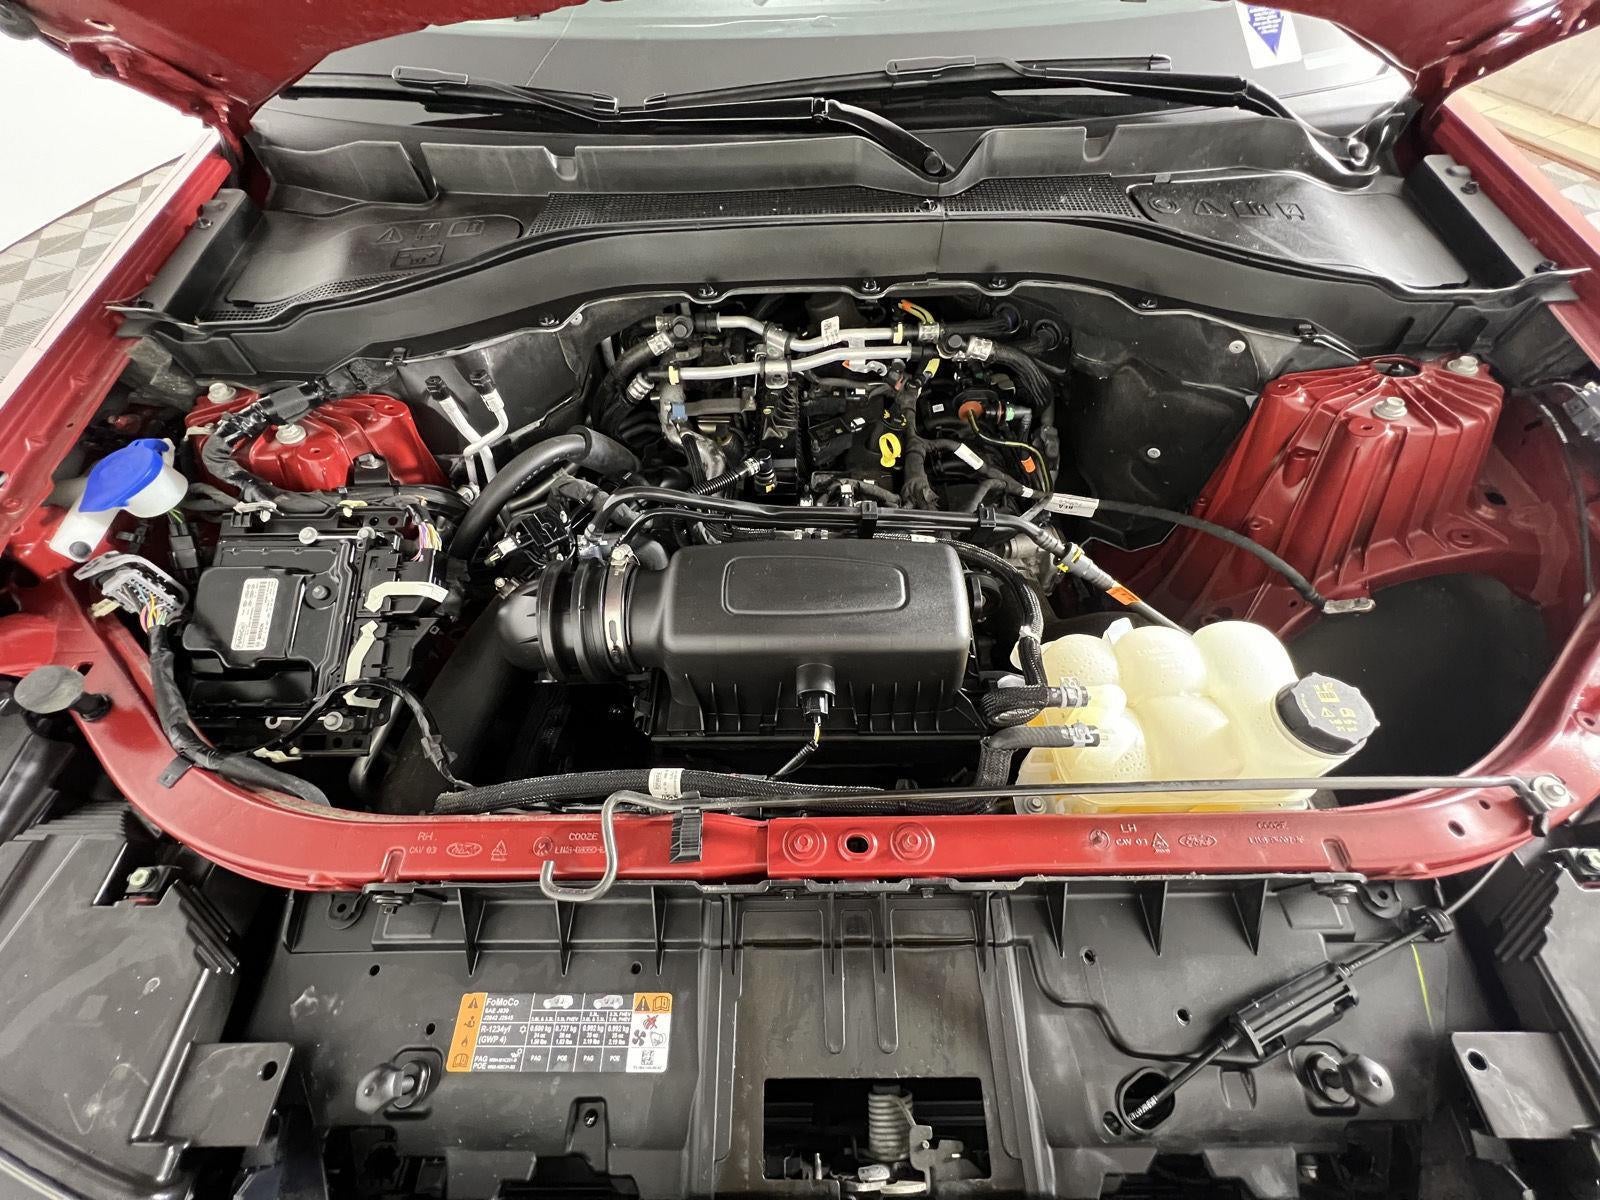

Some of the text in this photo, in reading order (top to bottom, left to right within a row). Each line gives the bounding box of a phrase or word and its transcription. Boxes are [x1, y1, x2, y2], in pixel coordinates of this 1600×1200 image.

[1120, 823, 1137, 833] LH
[486, 997, 519, 1007] FoMoCo
[480, 1025, 512, 1035] R-1234yf
[545, 1025, 552, 1033] kg
[556, 1024, 577, 1033] 0.737 kg
[583, 1024, 604, 1033] 0.992 kg
[608, 1024, 630, 1033] 0.992 kg
[478, 1035, 507, 1045] (GWP 4)
[474, 1055, 488, 1063] PAG
[582, 1054, 594, 1062] PAG
